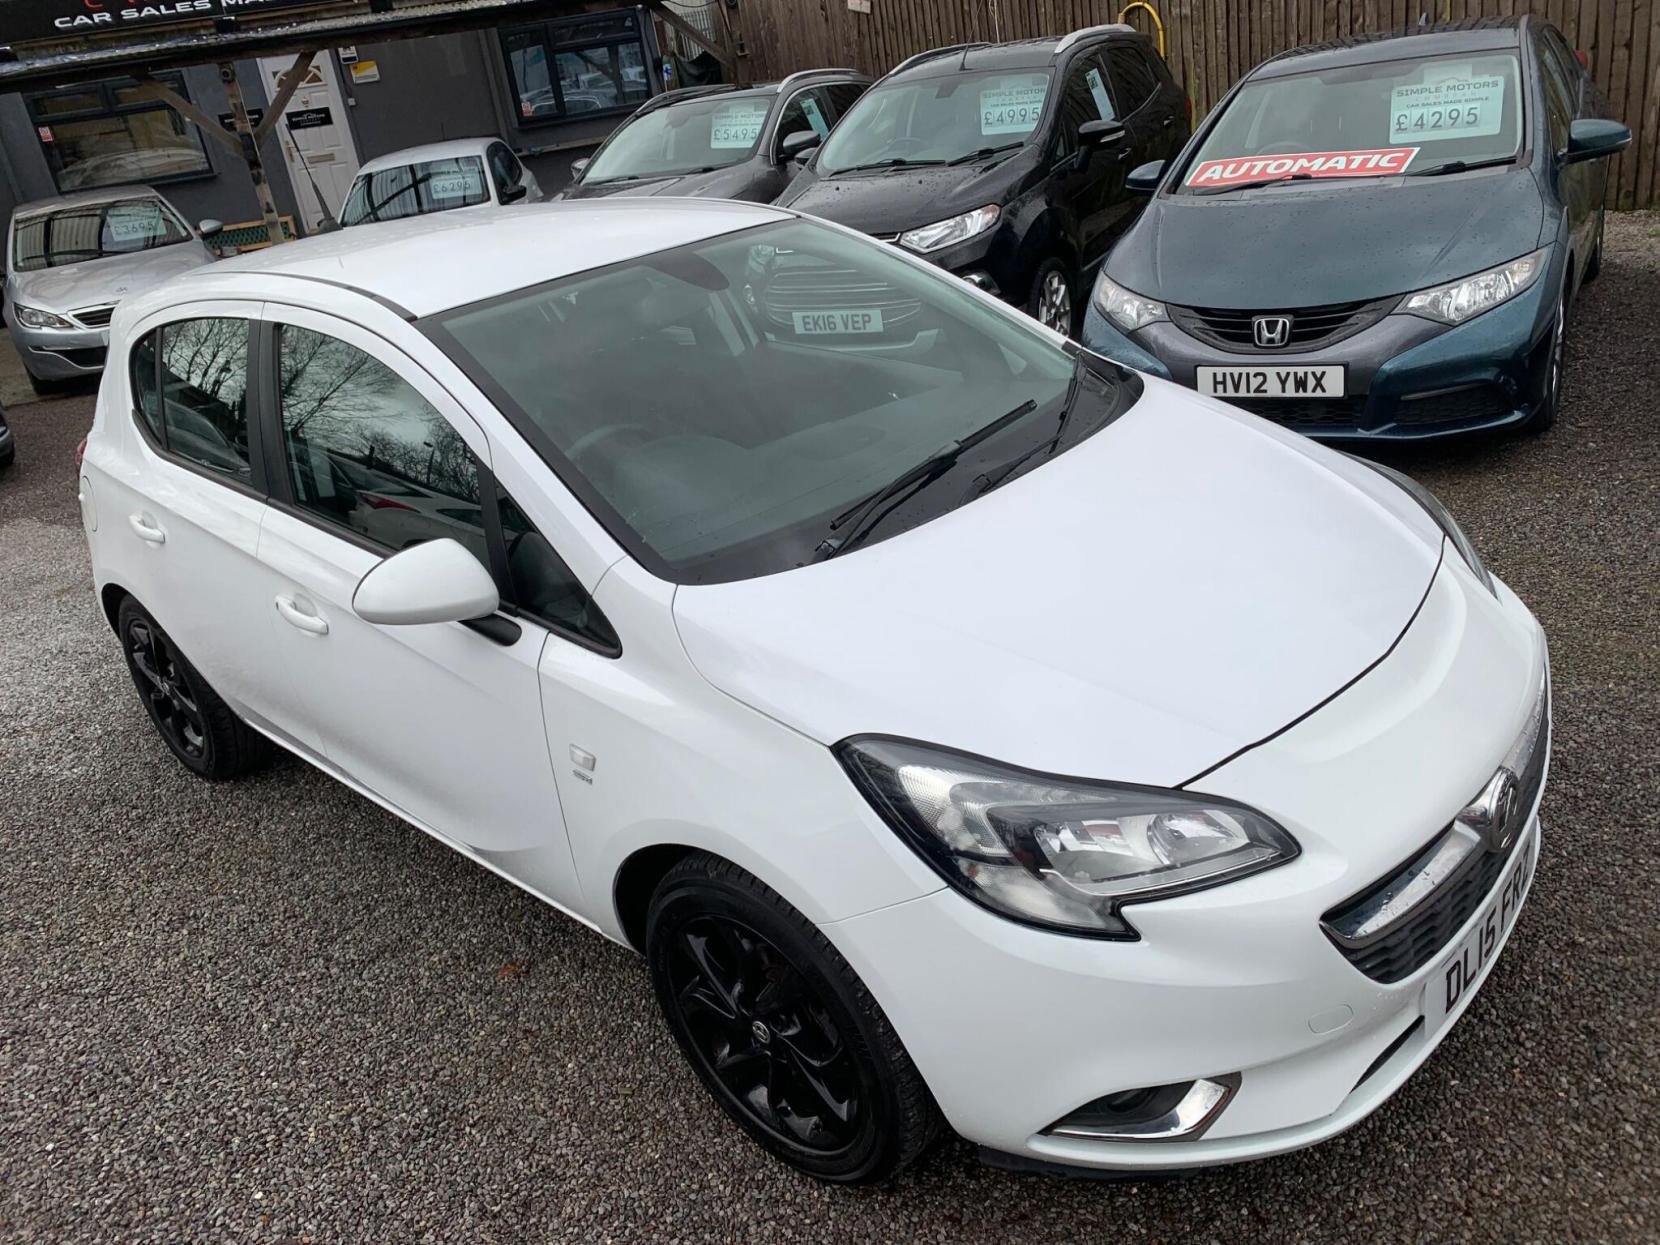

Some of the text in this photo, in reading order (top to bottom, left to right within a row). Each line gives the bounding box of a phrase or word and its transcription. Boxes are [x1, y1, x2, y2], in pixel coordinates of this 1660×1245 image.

[54, 12, 112, 28] CAR
[121, 0, 212, 20] SALES
[1396, 86, 1442, 98] SIMPLE
[1446, 79, 1499, 92] MOTORS
[984, 107, 1040, 126] £4995
[1395, 106, 1479, 132] £4295
[714, 127, 758, 141] £5495
[1197, 152, 1406, 183] AUTOMATIC
[433, 180, 471, 194] £6295
[802, 313, 872, 332] EK16 VEP
[1212, 370, 1327, 394] HV12 YWX
[1445, 905, 1497, 1014] DL15
